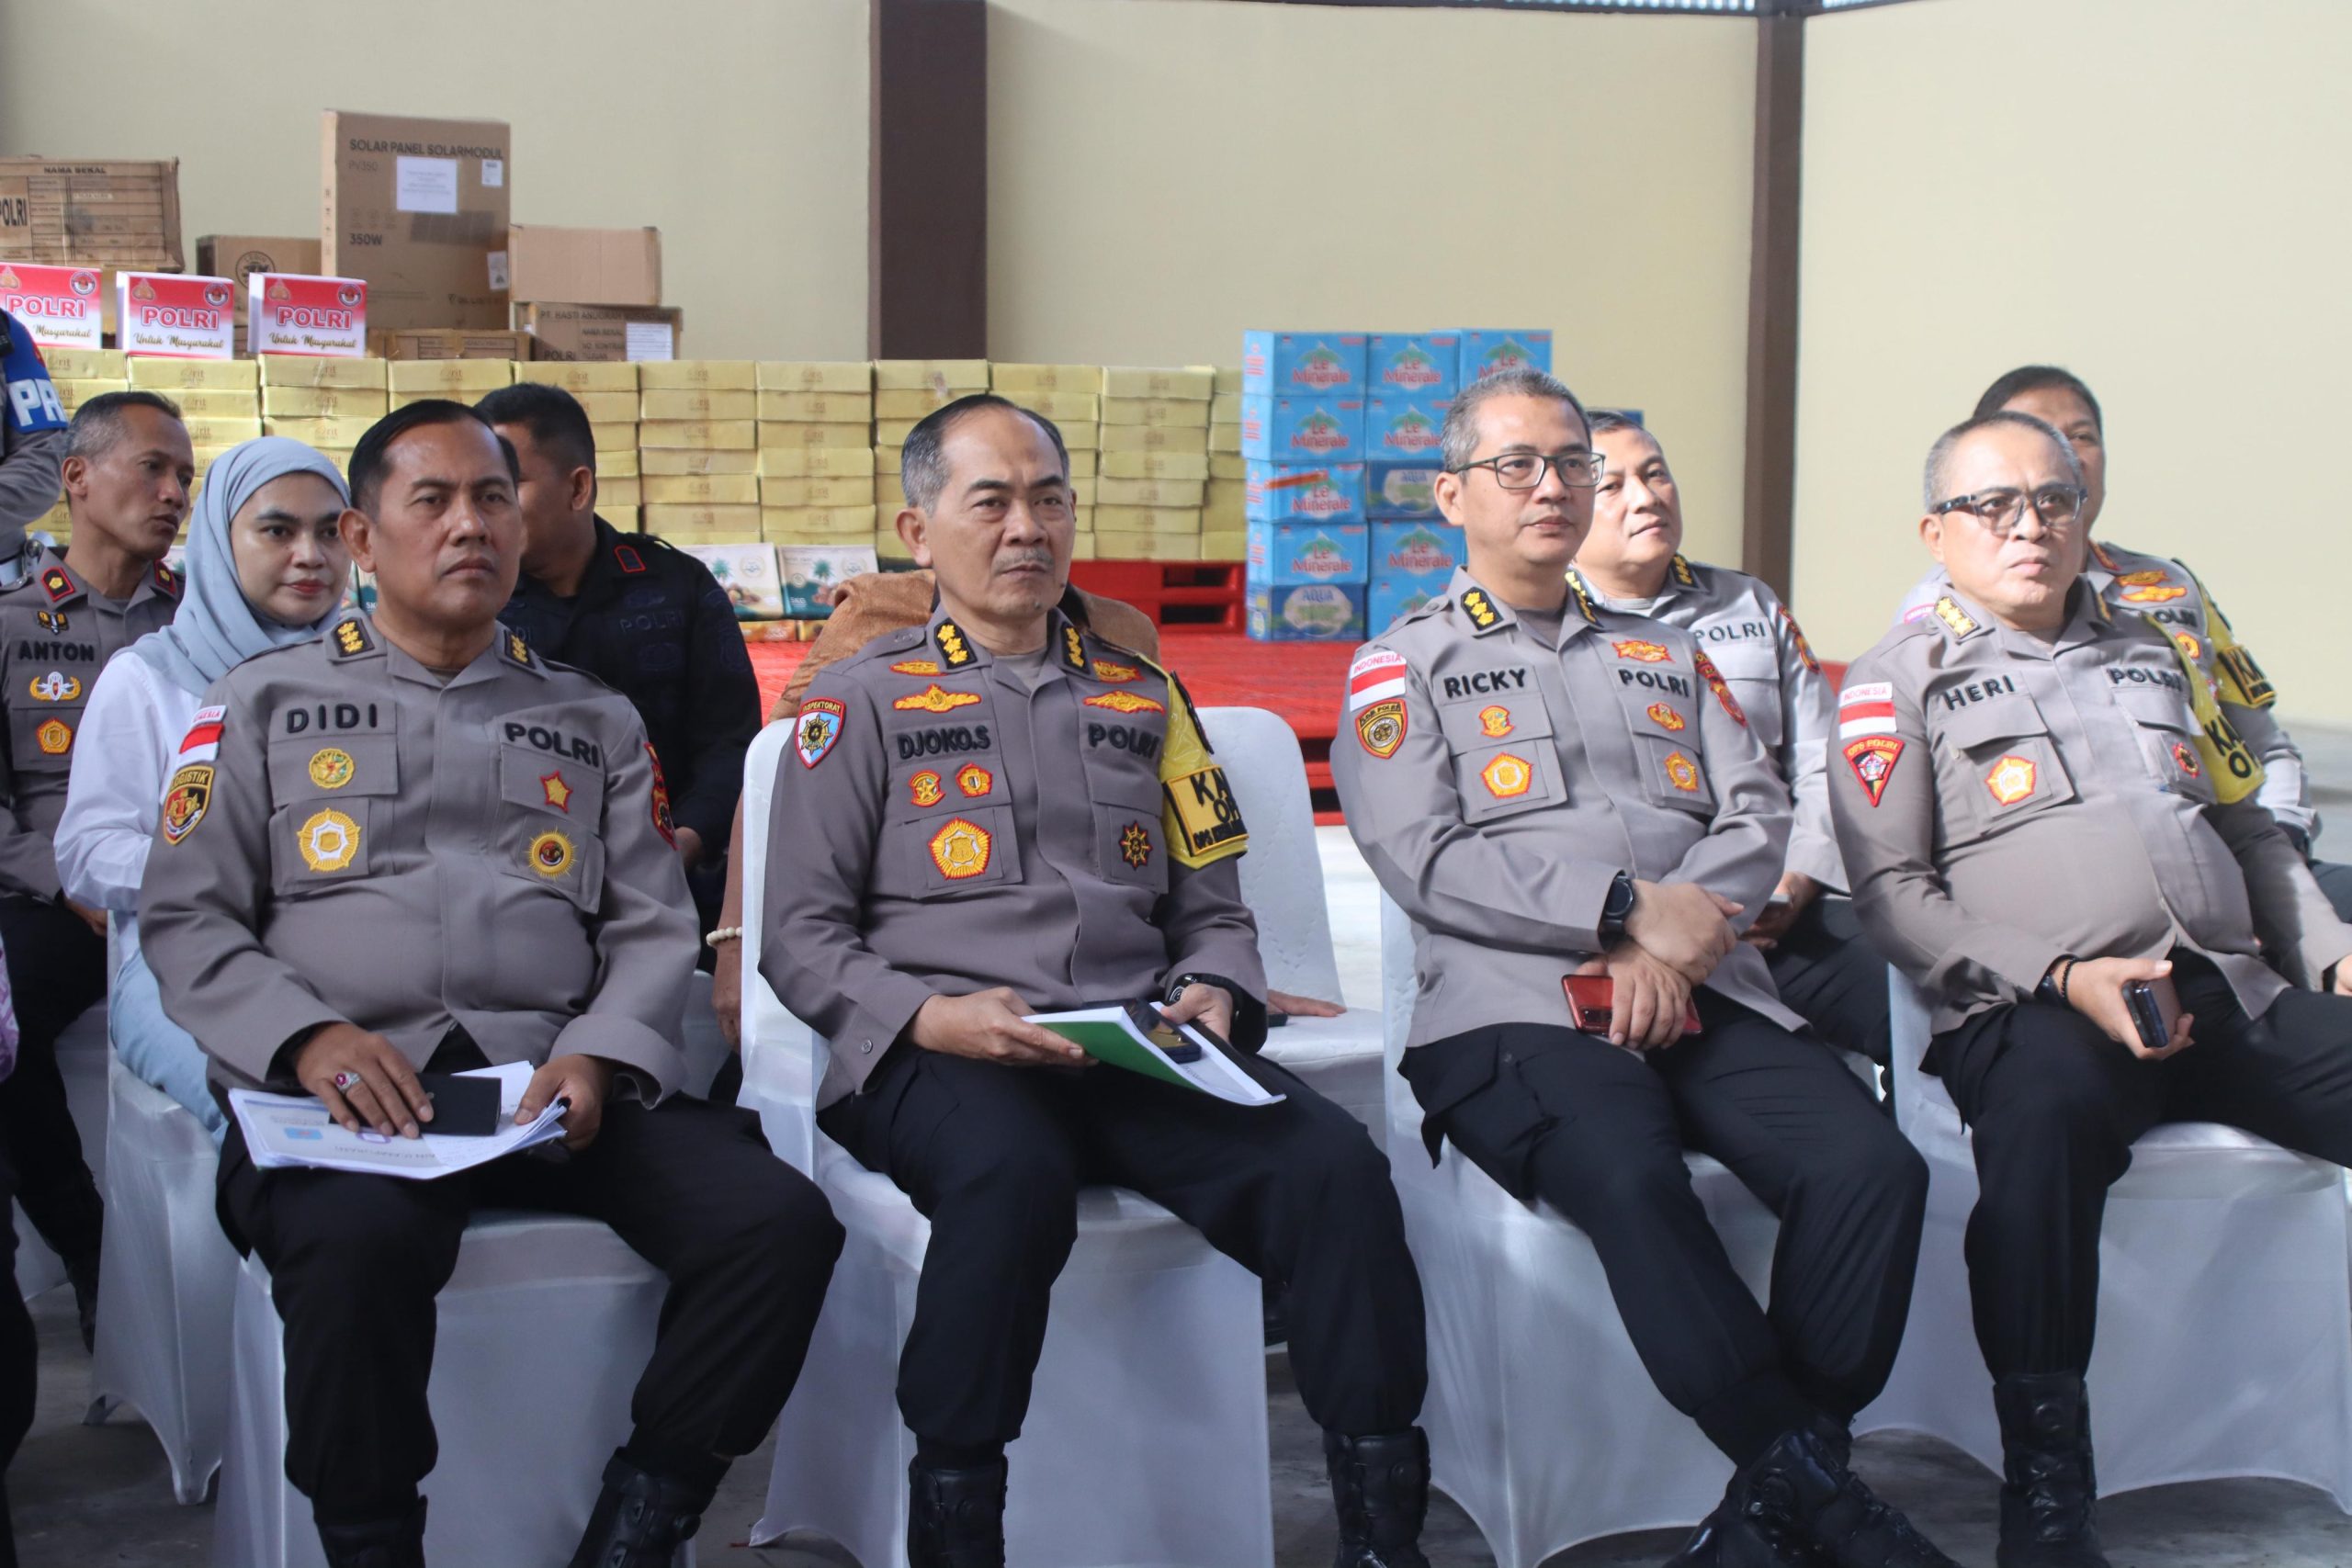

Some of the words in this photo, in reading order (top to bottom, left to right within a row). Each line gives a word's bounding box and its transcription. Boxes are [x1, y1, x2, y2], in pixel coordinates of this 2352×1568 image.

[350, 139, 388, 152] SOLAR
[390, 141, 424, 154] PANEL
[427, 144, 503, 160] SOLARMODUL
[349, 232, 382, 246] 350W
[6, 295, 86, 319] POLRI
[141, 306, 219, 330] POLRI
[277, 306, 352, 330] POLRI
[134, 332, 163, 345] Untuk
[269, 332, 297, 345] Untuk
[544, 350, 576, 361] POLRI
[1312, 355, 1329, 369] Le
[1404, 355, 1420, 369] Le
[1500, 351, 1518, 367] Le
[1292, 367, 1351, 383] Minerale
[1383, 369, 1442, 383] Minerale
[1311, 420, 1328, 434] Le
[1404, 419, 1420, 433] Le
[1291, 434, 1350, 448] Minerale
[1313, 485, 1329, 498] Le
[1291, 498, 1351, 512] Minerale
[1314, 544, 1330, 559] Le
[1411, 538, 1428, 553] Le
[1292, 558, 1352, 573] Minerale
[1388, 553, 1453, 568] Minerale
[1694, 622, 1766, 641] POLRI
[18, 641, 95, 661] ANTON
[1354, 653, 1402, 673] INDONESIA
[1443, 668, 1526, 699] RICKY
[1618, 668, 1690, 698] POLRI
[2109, 666, 2184, 694] POLRI
[1844, 686, 1887, 700] INDONESIA
[1943, 675, 2016, 711] HERI
[803, 701, 841, 713] INSPEKTORAT
[287, 704, 378, 734] DIDI
[504, 722, 599, 768] POLRI
[1848, 741, 1865, 756] OPS
[1867, 739, 1898, 750] POLRI
